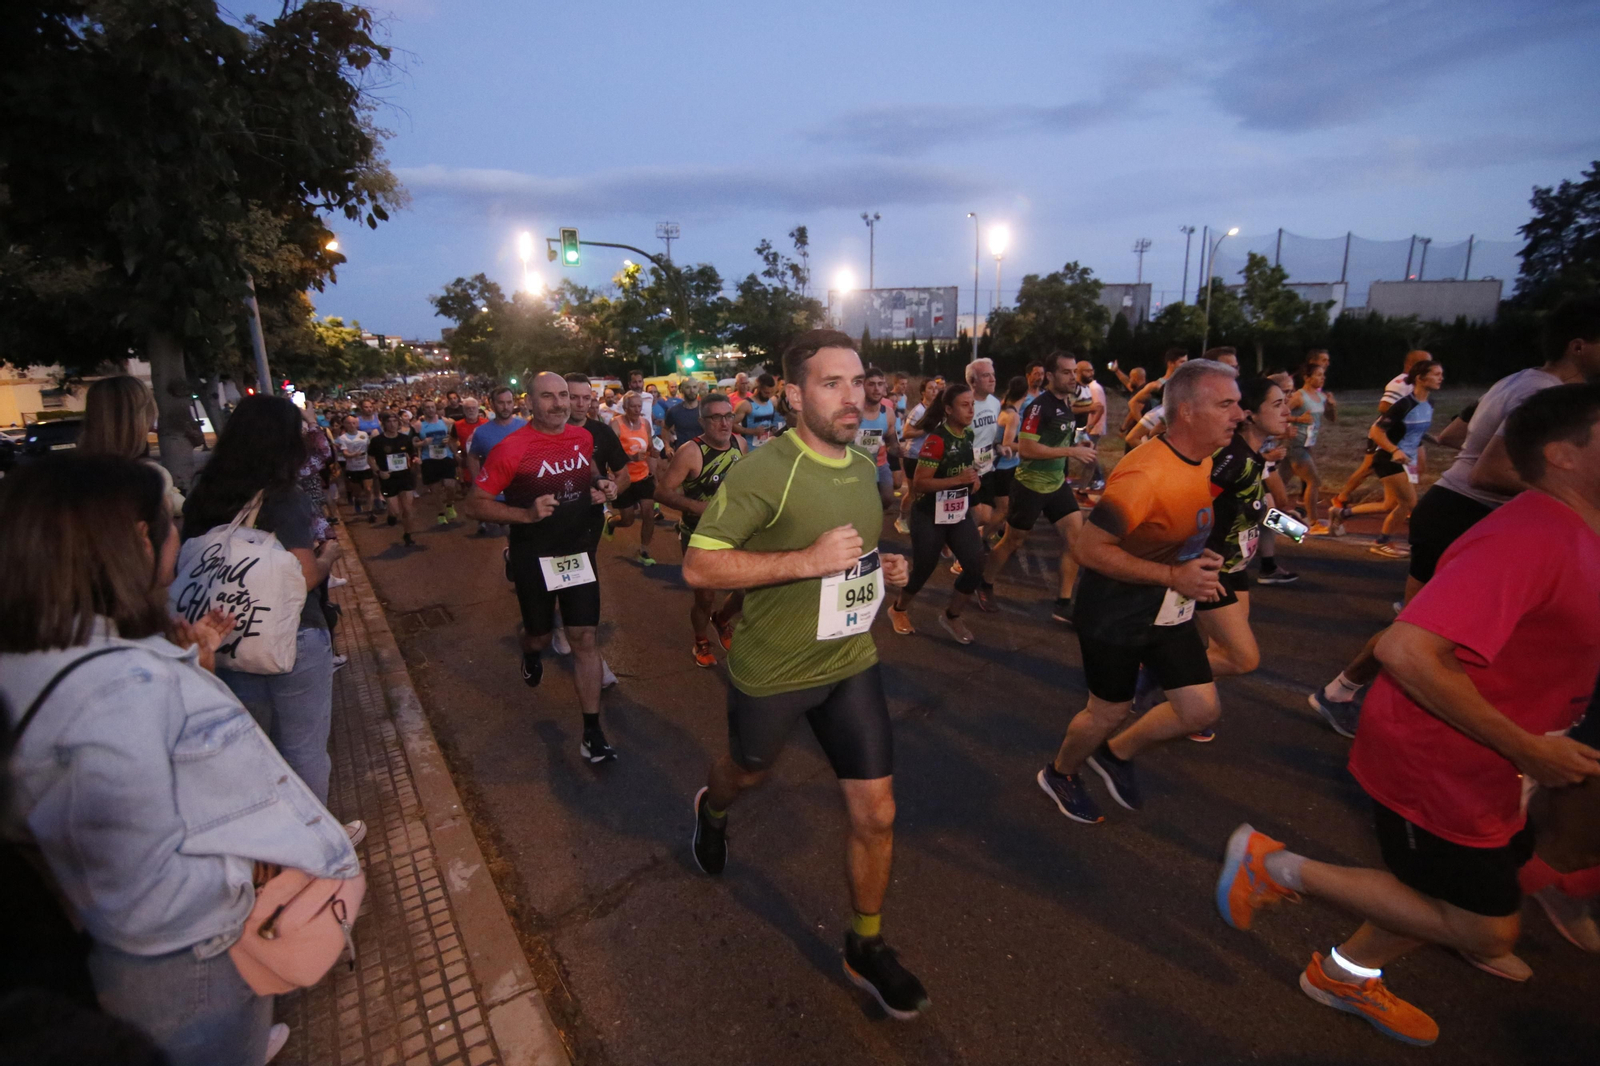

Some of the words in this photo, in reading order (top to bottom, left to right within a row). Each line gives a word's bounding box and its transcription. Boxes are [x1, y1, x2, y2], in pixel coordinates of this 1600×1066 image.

[944, 501, 965, 512] 1537
[189, 543, 260, 588] Small
[556, 558, 580, 573] 573
[561, 573, 571, 582] H
[216, 589, 260, 612] acts
[845, 582, 874, 608] 948
[176, 582, 271, 637] CHAGE
[846, 612, 858, 627] H
